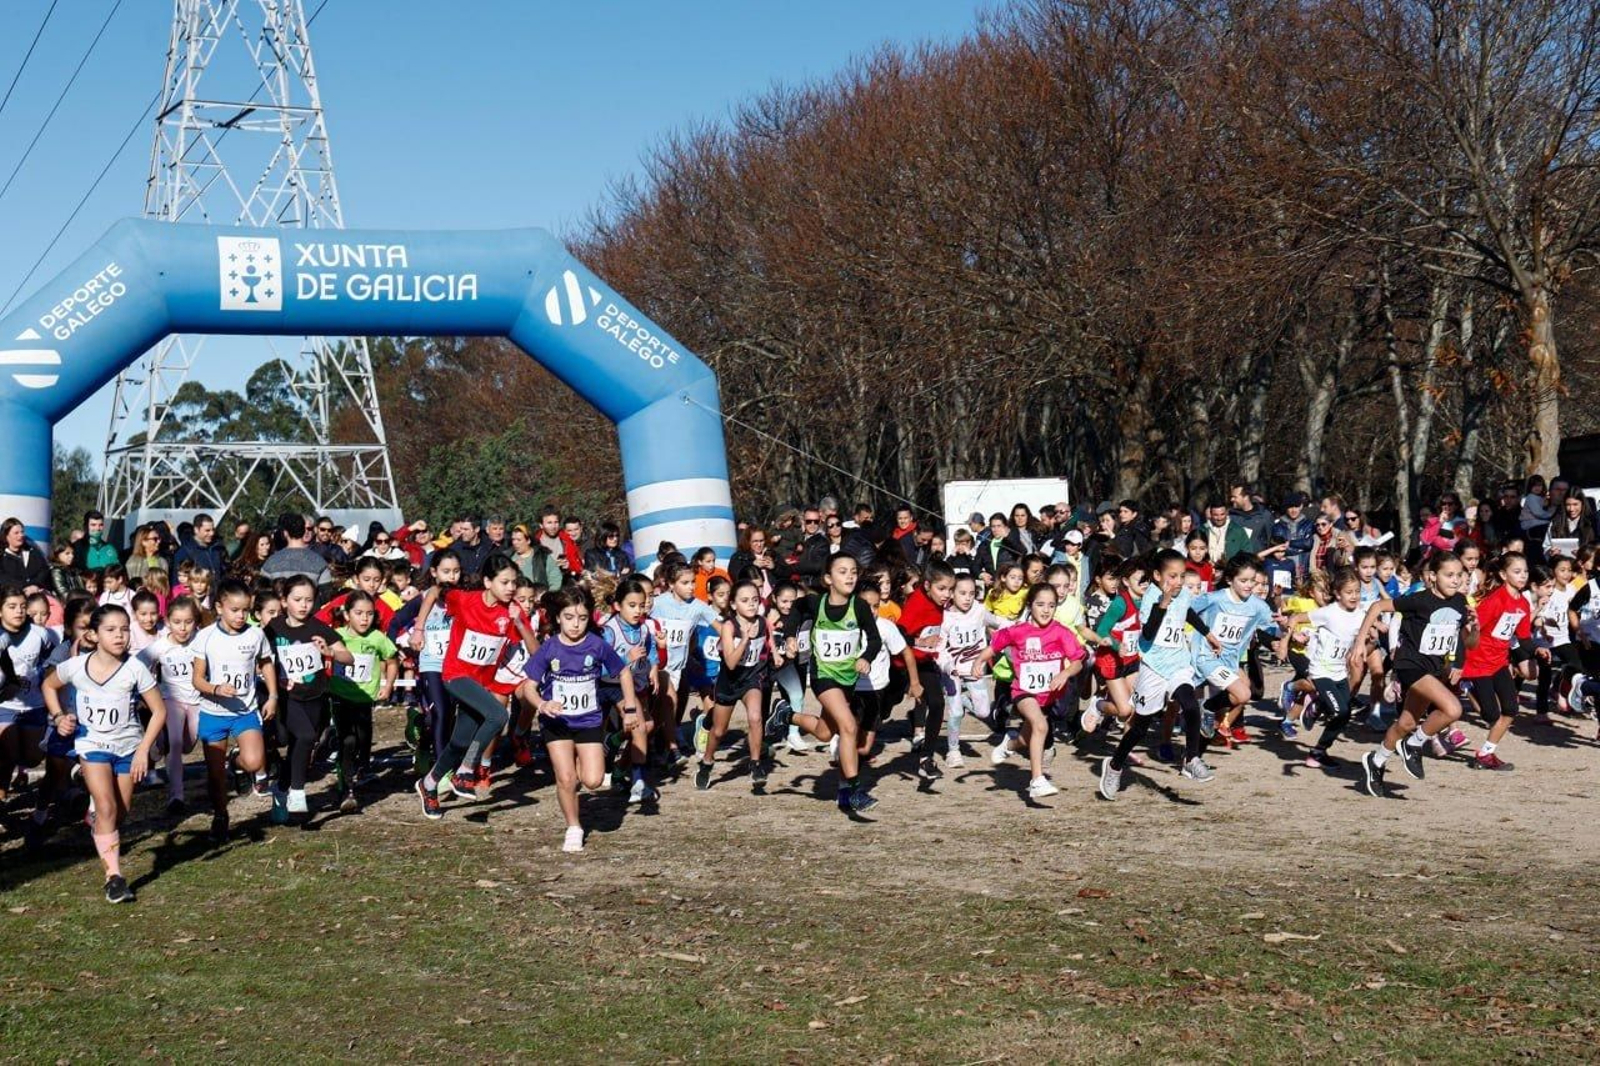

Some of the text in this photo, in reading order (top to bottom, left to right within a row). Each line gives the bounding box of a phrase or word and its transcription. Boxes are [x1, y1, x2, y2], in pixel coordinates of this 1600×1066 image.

[294, 243, 408, 268] XUNTA
[39, 262, 122, 329] DEPORTE
[297, 272, 477, 302] DE GALICIA
[54, 282, 126, 340] GALEGO
[597, 315, 664, 368] GALEGO
[605, 303, 680, 364] DEPORTE
[1219, 624, 1244, 640] 266
[467, 644, 496, 661] 307
[823, 641, 851, 657] 250
[286, 654, 315, 674] 292
[223, 672, 251, 690] 268
[559, 694, 589, 710] 290
[85, 706, 120, 725] 270
